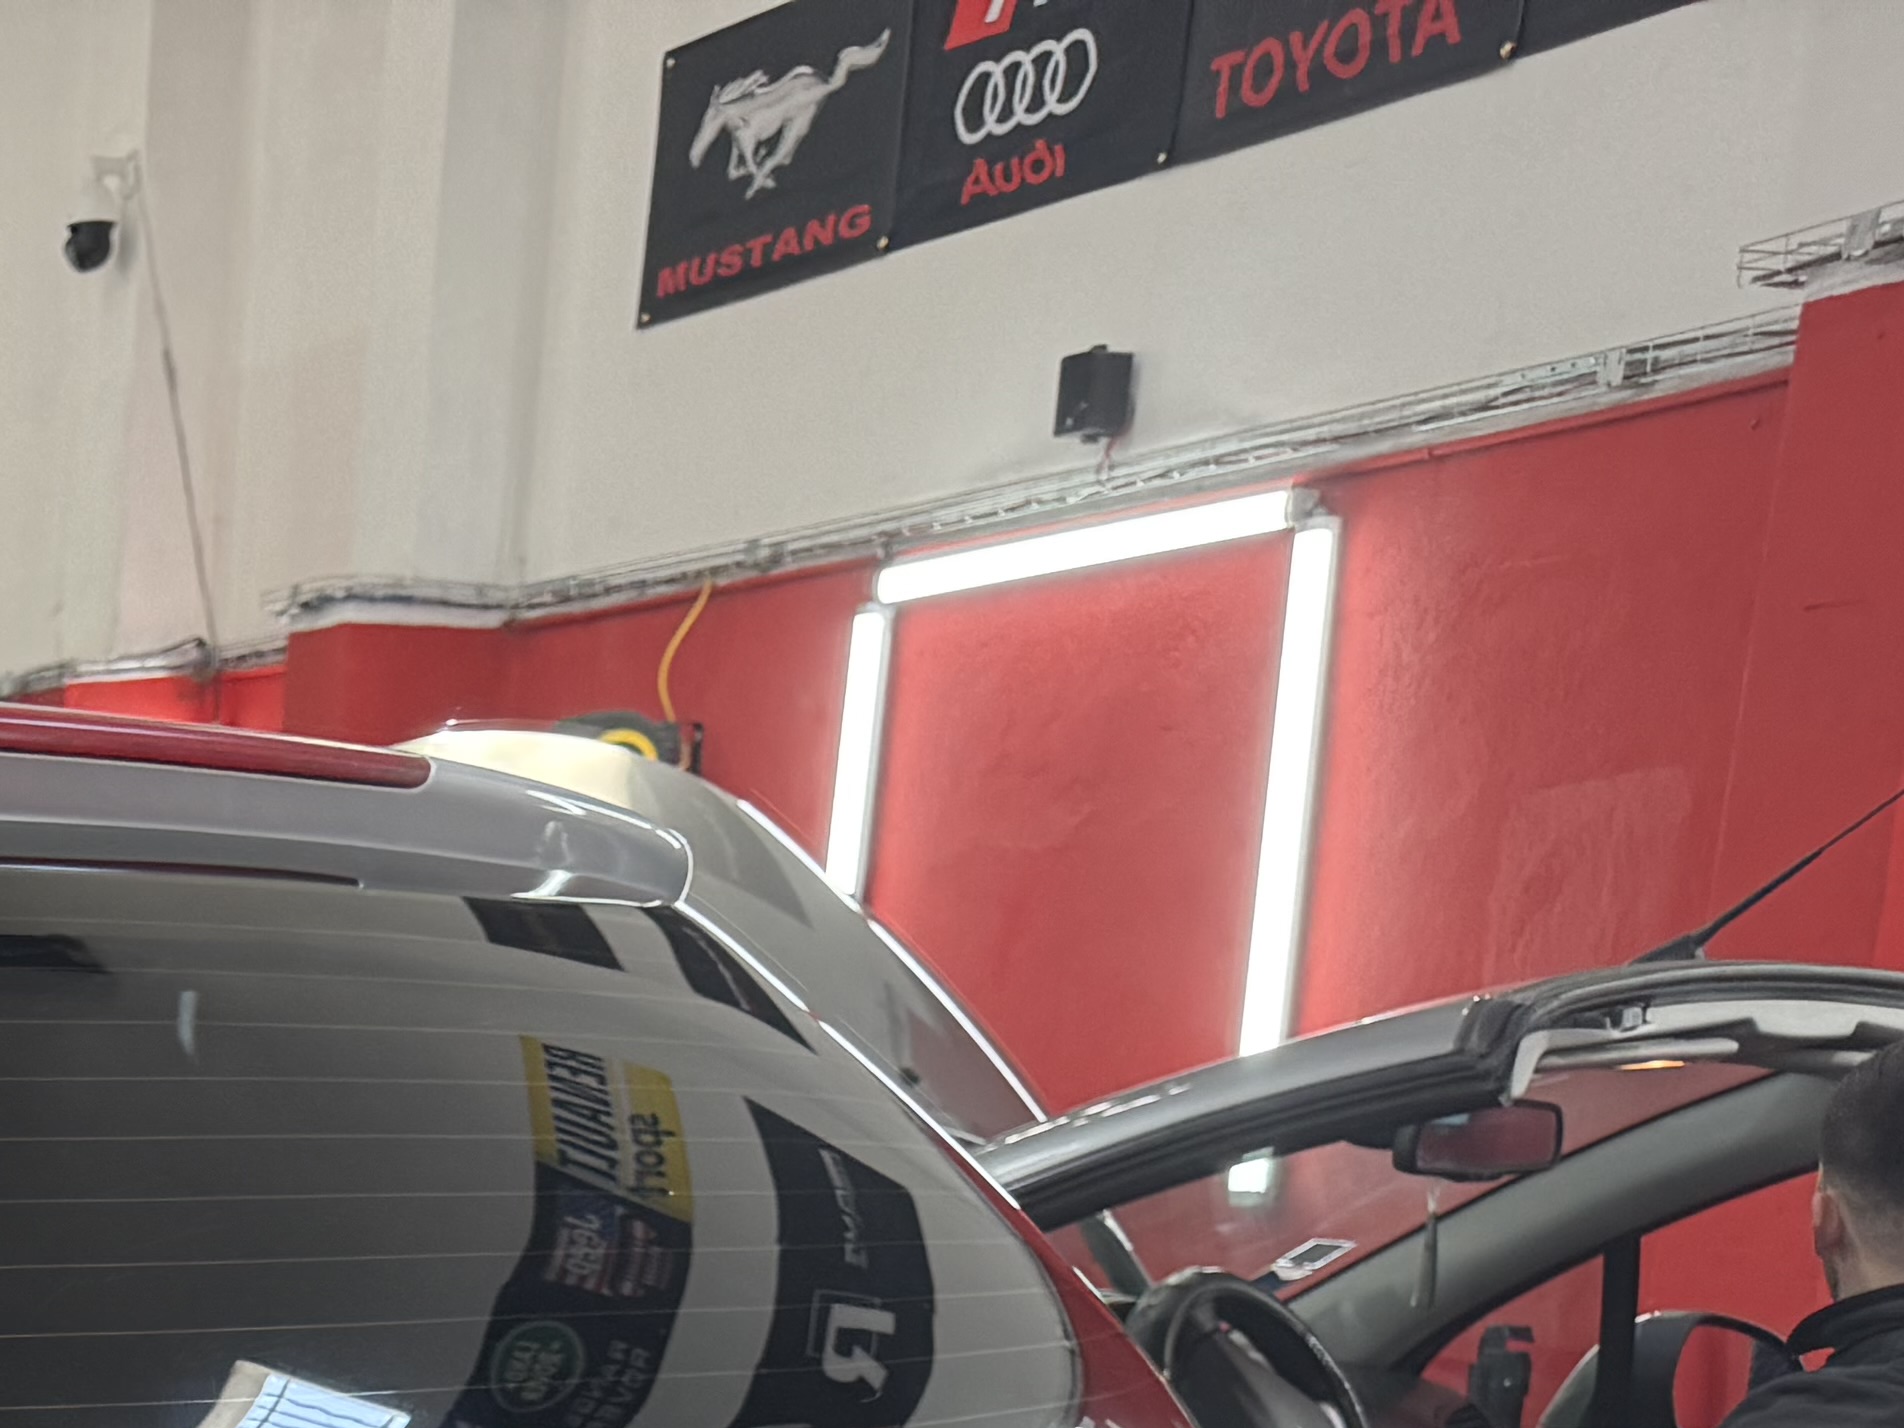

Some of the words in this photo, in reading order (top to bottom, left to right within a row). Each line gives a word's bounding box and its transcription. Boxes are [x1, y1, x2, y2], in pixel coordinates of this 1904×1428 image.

[1209, 0, 1463, 118] TOYOTA
[961, 137, 1066, 205] Audi
[656, 203, 873, 298] MUSTANG
